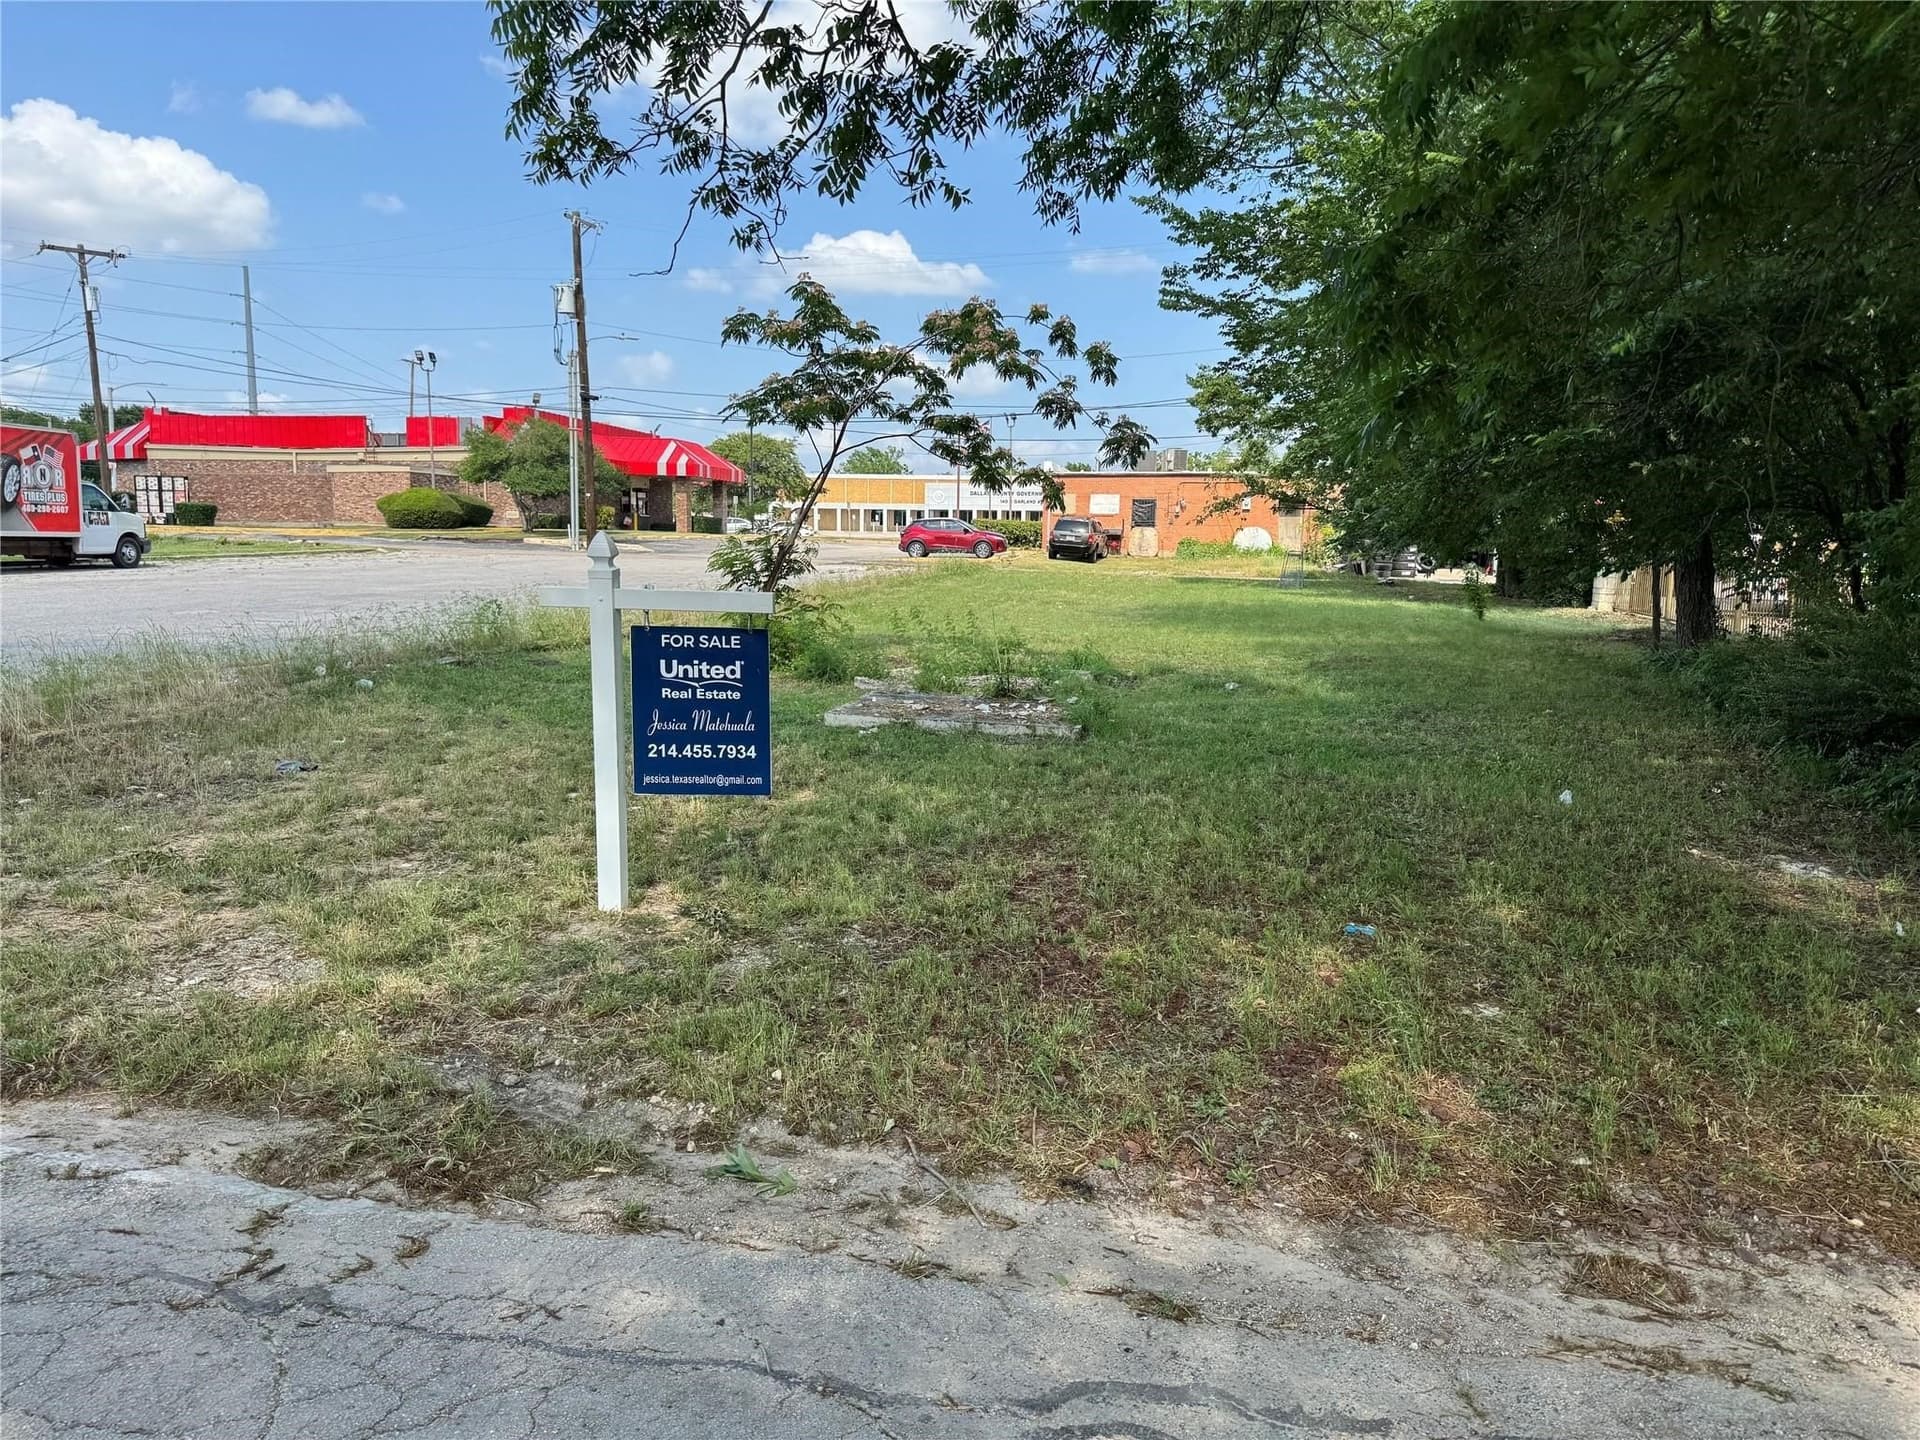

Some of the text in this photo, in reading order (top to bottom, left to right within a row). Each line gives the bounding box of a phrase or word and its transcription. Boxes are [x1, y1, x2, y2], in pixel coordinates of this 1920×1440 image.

[23, 491, 66, 502] TIRES PLUS
[661, 634, 741, 649] FOR SALE
[659, 659, 742, 679] United
[661, 688, 741, 700] Real Estate
[647, 708, 756, 736] Jessica Matehuala
[647, 743, 757, 759] 214.455.7934
[643, 773, 763, 787] jessica.texasrealtor@gmail.com
